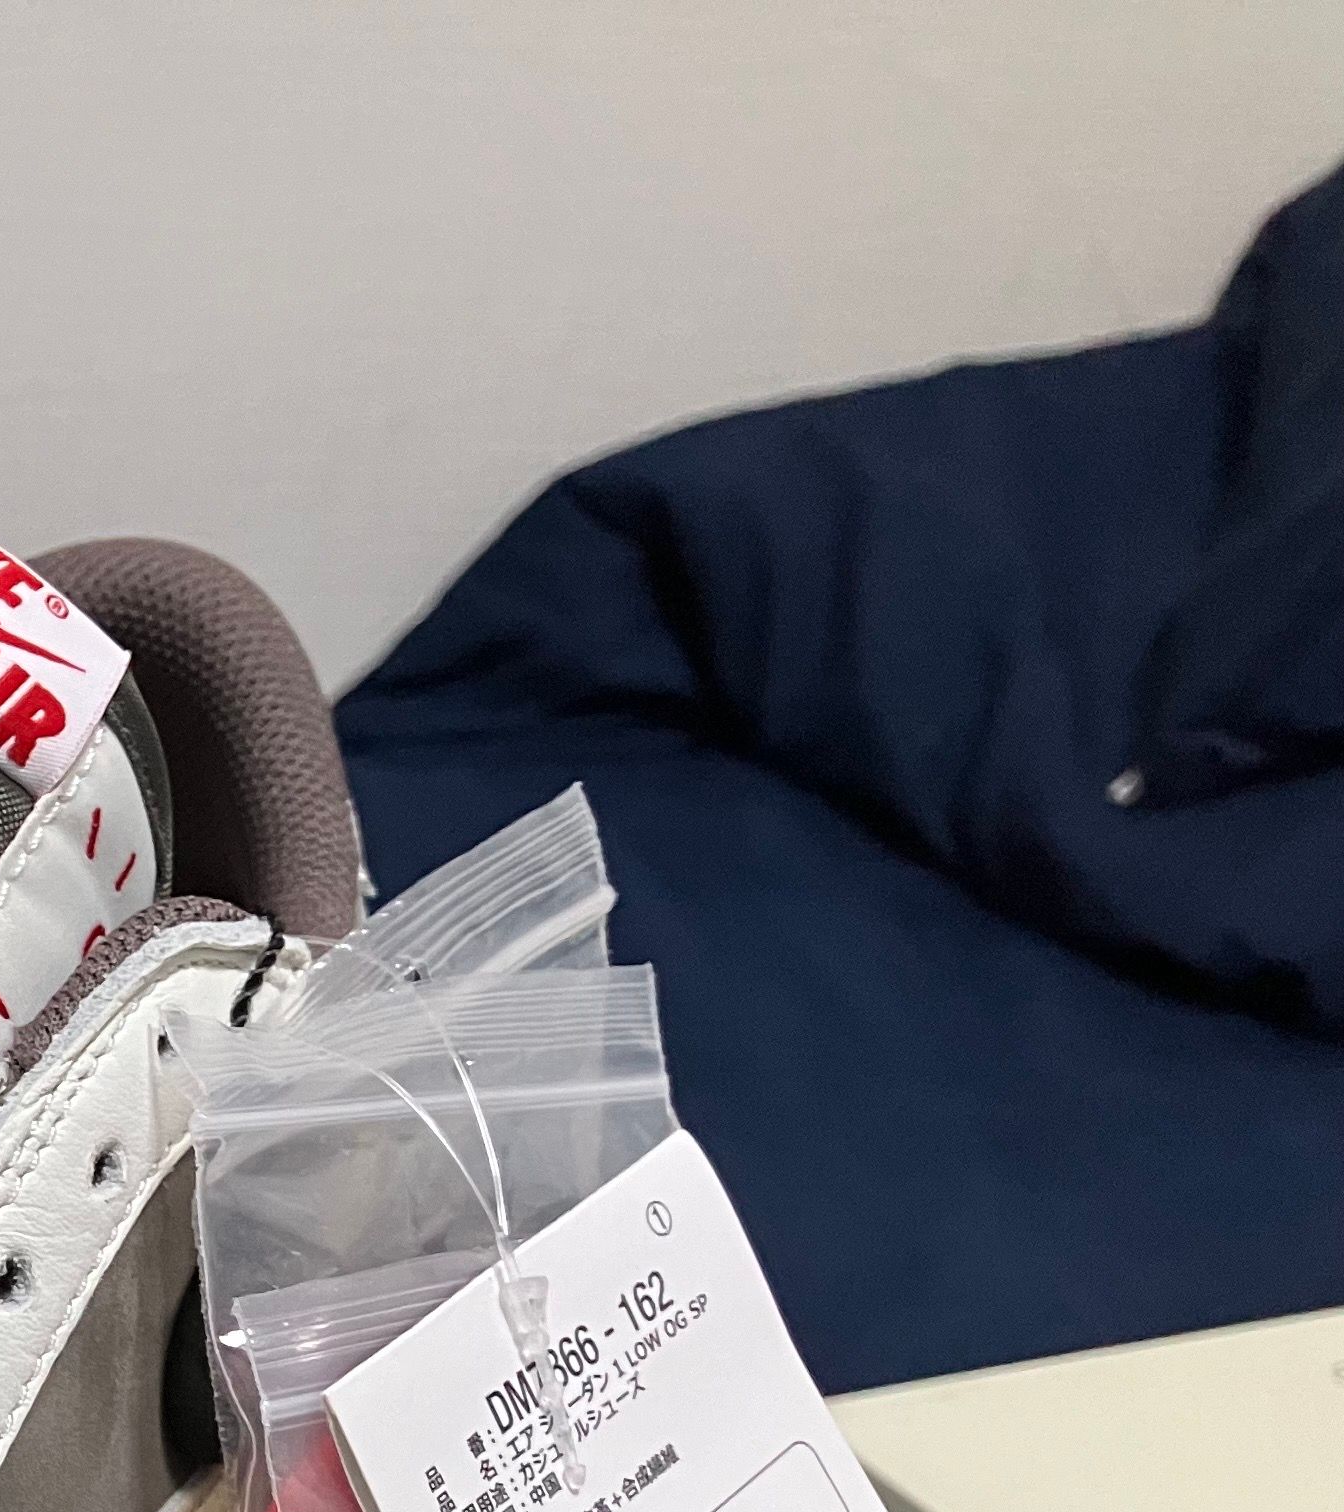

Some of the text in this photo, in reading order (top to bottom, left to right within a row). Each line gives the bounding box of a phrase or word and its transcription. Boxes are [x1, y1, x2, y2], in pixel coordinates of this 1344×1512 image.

[618, 1271, 674, 1331] 162
[624, 1332, 662, 1367] LOW
[664, 1310, 688, 1338] OG
[688, 1293, 708, 1320] SP
